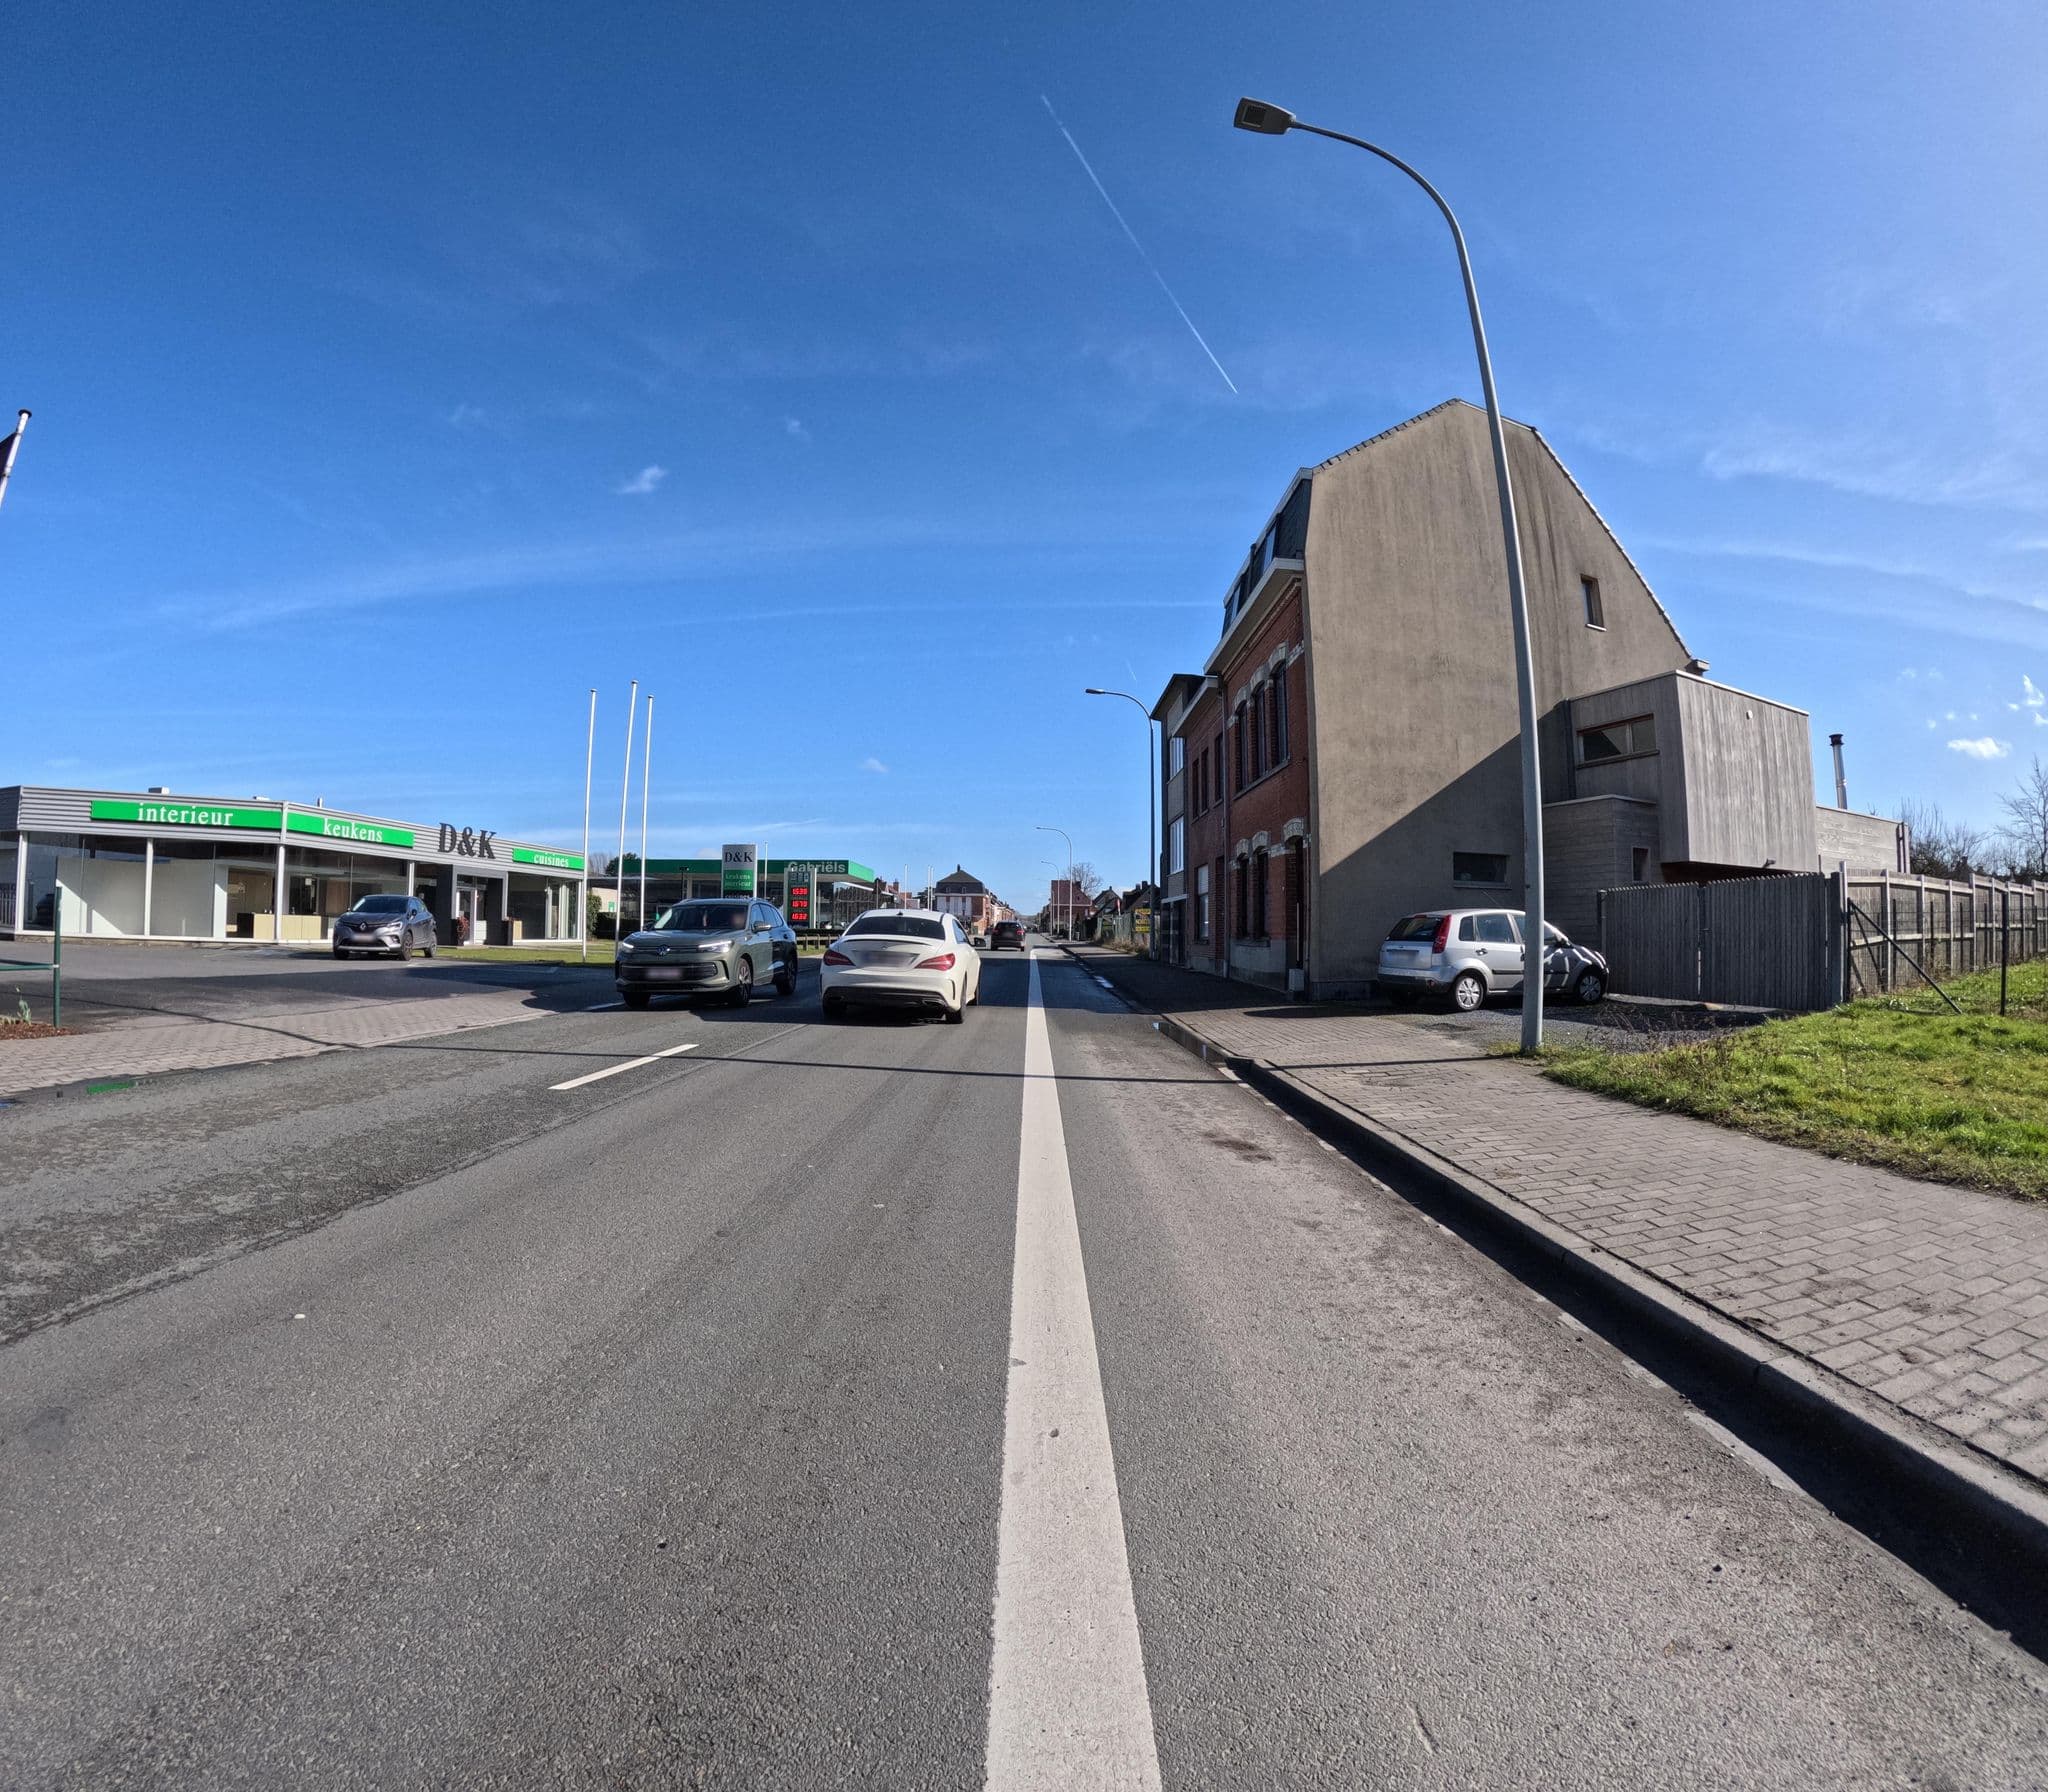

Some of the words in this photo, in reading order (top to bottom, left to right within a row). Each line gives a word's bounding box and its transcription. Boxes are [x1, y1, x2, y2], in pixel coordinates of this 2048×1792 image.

[137, 802, 234, 826] interieur
[323, 817, 384, 843] keukens
[438, 822, 497, 859] D&K
[533, 851, 569, 868] cuisines
[724, 851, 753, 863] D&K
[788, 861, 846, 873] Gabriëls
